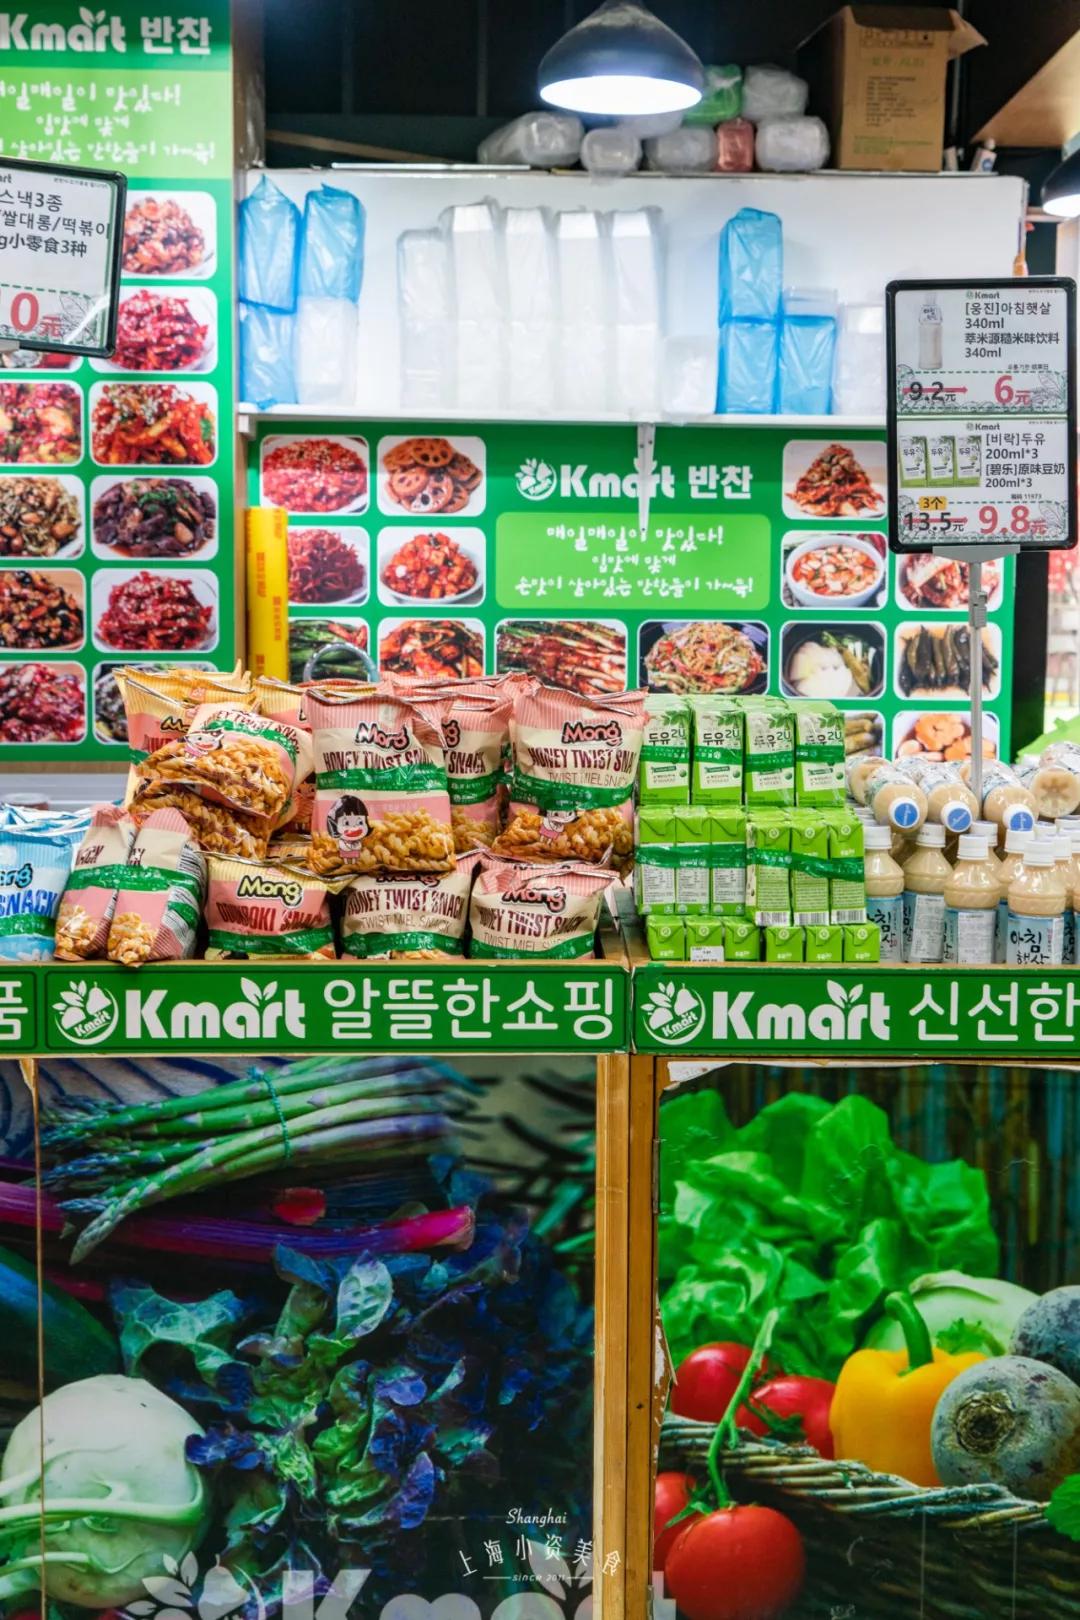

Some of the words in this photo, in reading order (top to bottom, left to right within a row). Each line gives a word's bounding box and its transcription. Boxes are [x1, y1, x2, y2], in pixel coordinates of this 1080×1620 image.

[140, 16, 211, 55] 반찬
[975, 291, 1000, 299] Kmart
[965, 302, 1051, 315] [웅진]아침햇살
[965, 317, 1004, 329] 340ml
[965, 347, 1001, 358] 340ml
[975, 423, 1000, 431] Kmart
[986, 433, 1046, 447] [비락]두유
[986, 463, 1065, 475] [碧乐]原味豆奶
[688, 465, 753, 499] 반찬
[592, 553, 639, 573] 입맛에
[562, 721, 622, 746] Mong
[449, 752, 486, 774] SNACK
[237, 875, 303, 907] Mong
[384, 888, 428, 911] TWIST
[1010, 928, 1042, 953] 아침
[125, 979, 306, 1039] Kmart
[712, 981, 890, 1041] Kmart
[909, 981, 1080, 1042] 신선한
